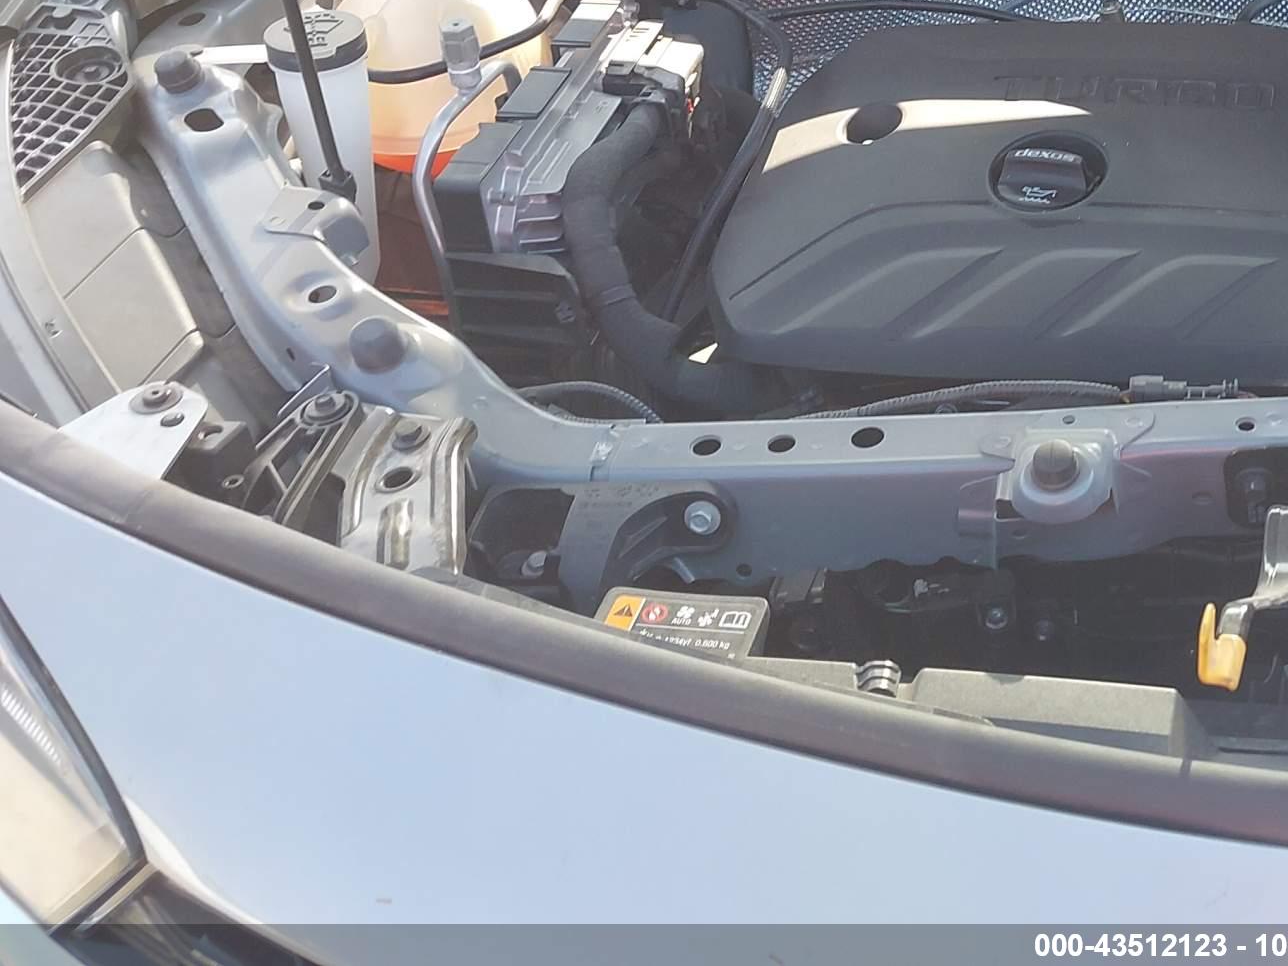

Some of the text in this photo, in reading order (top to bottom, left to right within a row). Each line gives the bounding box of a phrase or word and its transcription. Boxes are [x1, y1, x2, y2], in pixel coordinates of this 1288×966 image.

[993, 75, 1277, 110] TURBO
[1015, 148, 1079, 164] dexos
[671, 617, 692, 626] AUTO
